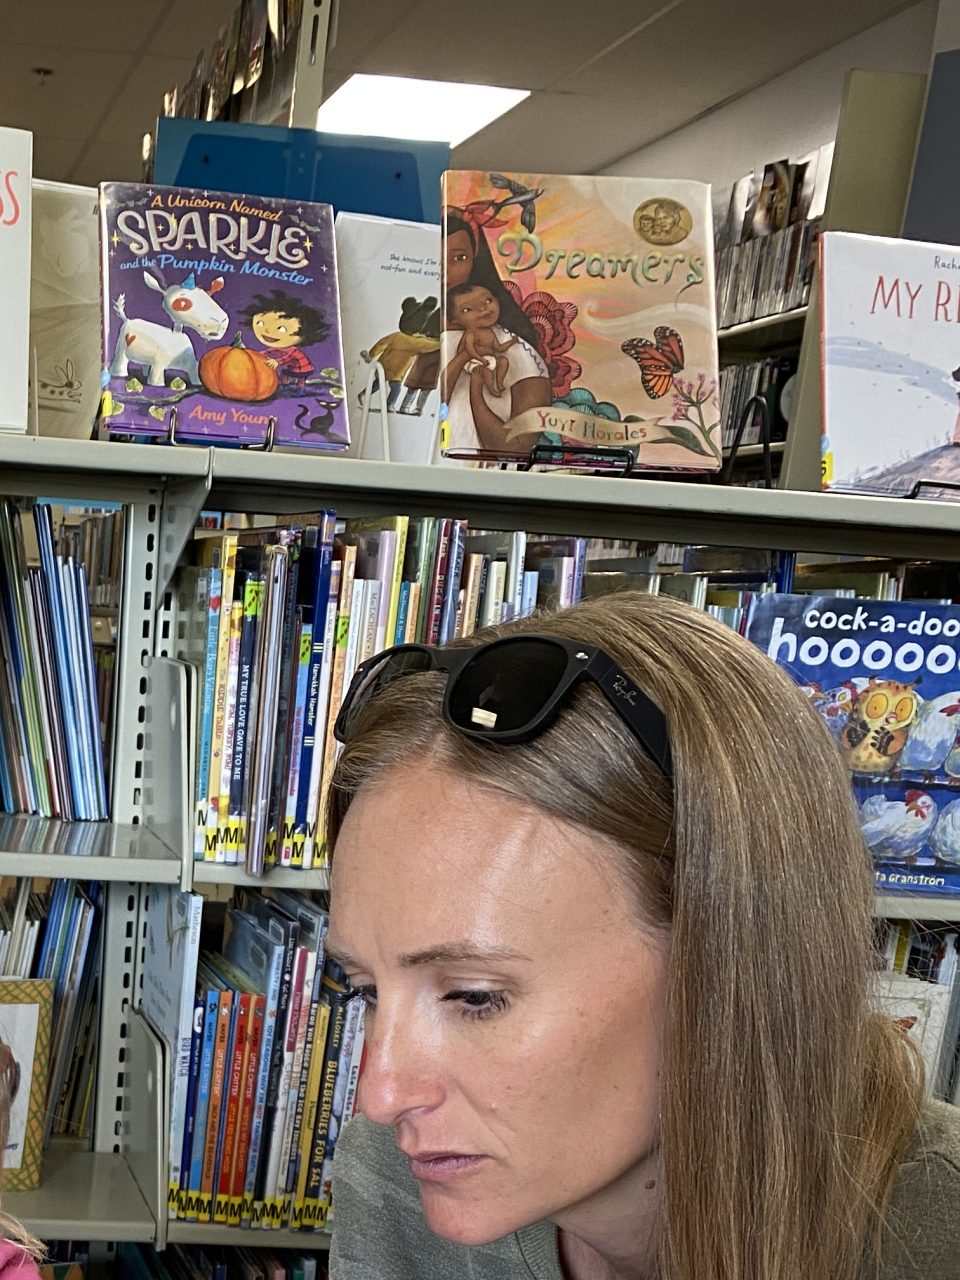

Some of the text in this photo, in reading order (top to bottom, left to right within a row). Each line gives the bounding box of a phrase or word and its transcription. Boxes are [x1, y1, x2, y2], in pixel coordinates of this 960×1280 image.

[151, 194, 284, 221] A Unicorn Named
[116, 210, 310, 270] SPARKLE
[120, 253, 315, 286] and the Pumpkin Monster
[495, 230, 705, 290] Dreamers
[870, 275, 923, 319] MY
[188, 404, 272, 426] Amy Youn
[582, 421, 648, 441] Morales
[233, 664, 249, 780] MY TRUE LOVE GAVE TO ME
[205, 835, 216, 851] M
[227, 827, 238, 843] M
[292, 841, 304, 858] M
[888, 873, 945, 887] Granström
[191, 906, 201, 945] Matheson
[310, 1060, 337, 1187] BLUEBERRIES FOR SAL
[168, 1189, 180, 1203] M
[200, 1200, 211, 1214] M
[230, 1203, 241, 1217] M
